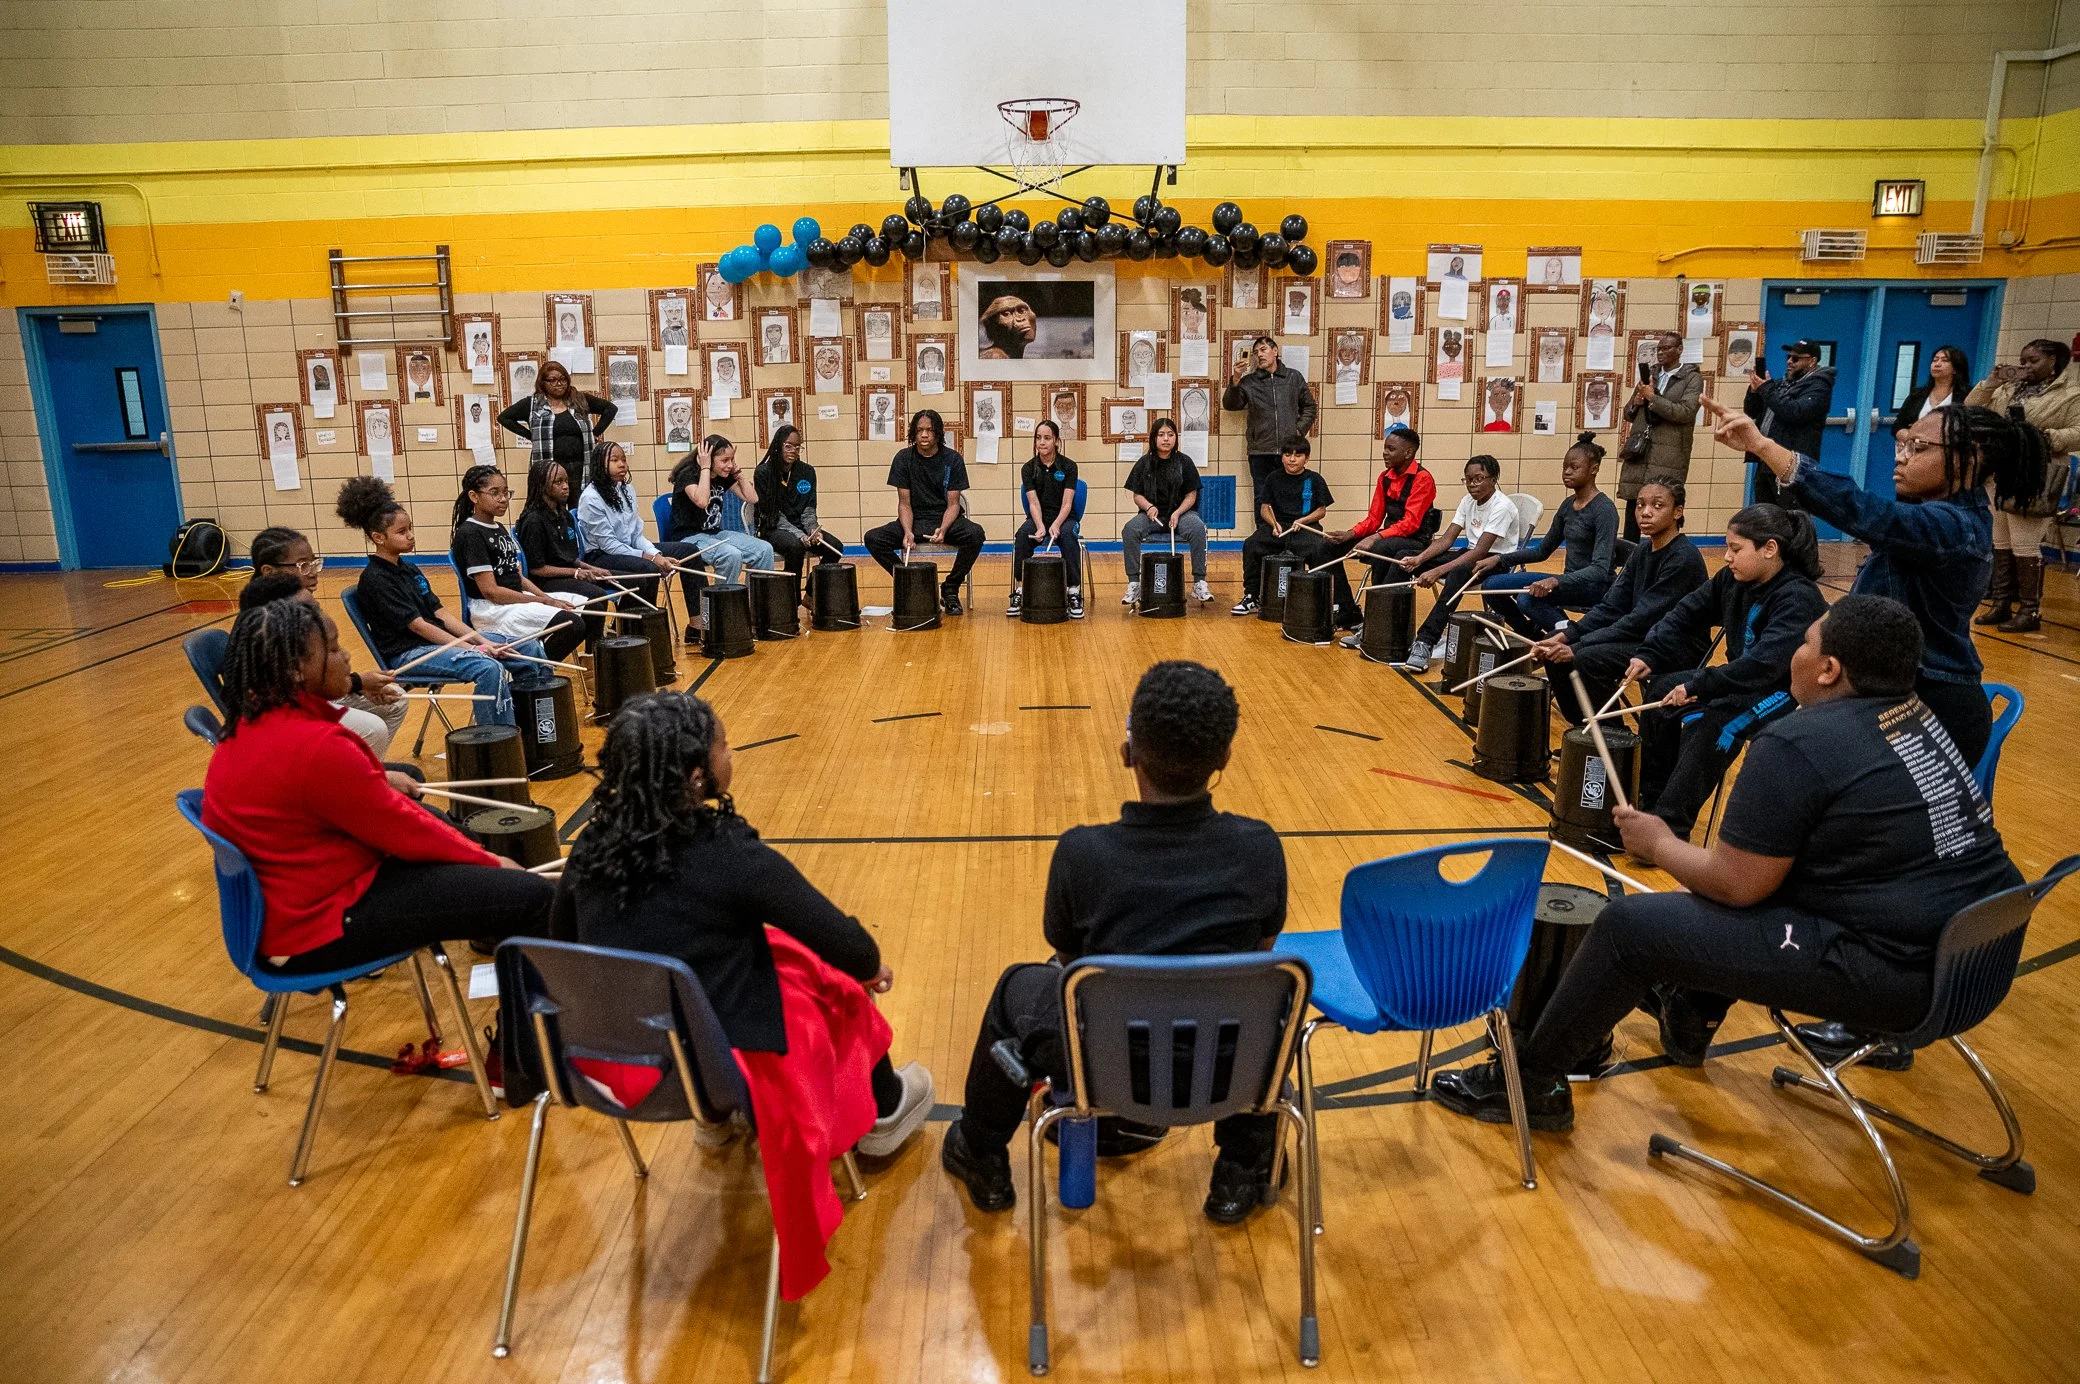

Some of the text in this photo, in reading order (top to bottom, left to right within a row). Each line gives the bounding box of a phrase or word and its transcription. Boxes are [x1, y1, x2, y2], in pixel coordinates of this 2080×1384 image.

[1885, 185, 1915, 212] EXIT
[53, 213, 83, 241] EXIT
[1878, 703, 1909, 721] SERENA
[1879, 713, 1907, 731] GRAND
